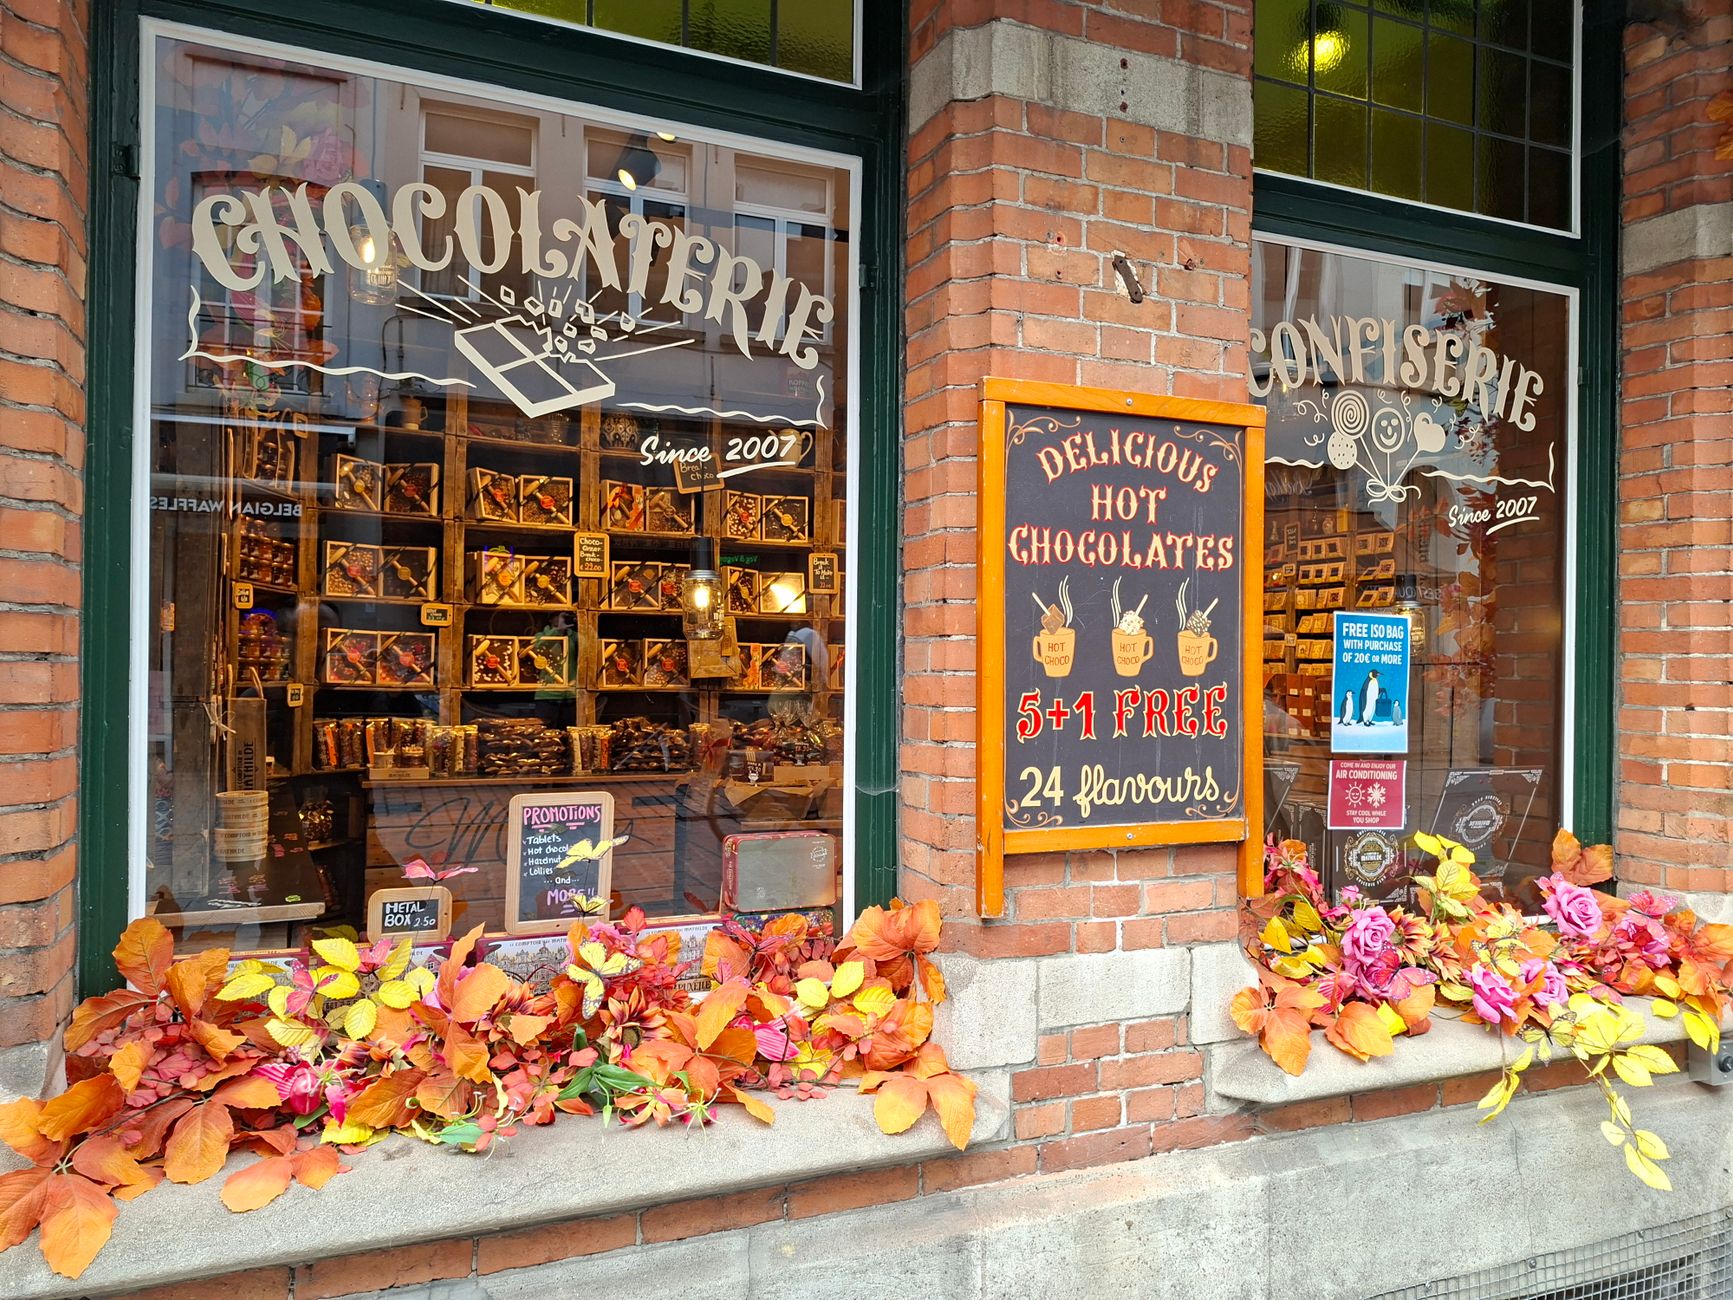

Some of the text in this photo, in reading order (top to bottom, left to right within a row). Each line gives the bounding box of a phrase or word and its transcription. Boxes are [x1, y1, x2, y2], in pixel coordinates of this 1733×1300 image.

[192, 181, 834, 370] CHOCOLATERIE
[1249, 314, 1544, 432] CONFISERIE
[640, 435, 798, 466] Since 2007
[1036, 429, 1219, 493] DELICIOUS
[1090, 483, 1166, 524] HOT
[1448, 496, 1537, 528] Since 2007
[1007, 522, 1234, 571] CHOCOLATES
[1342, 622, 1404, 639] FREE ISO BAG
[1048, 642, 1065, 652] HOT
[1119, 643, 1137, 652] HOT
[1185, 645, 1202, 655] HOT
[1343, 639, 1402, 651] WITH PURCHASE
[1044, 655, 1070, 665] CHOCO
[1116, 655, 1141, 665] CHOCO
[1181, 655, 1204, 666] CHOCO
[1342, 652, 1402, 664] OF 20€ OR MORE
[1016, 681, 1229, 744] 5+1 FREE
[1335, 769, 1398, 780] AIR CONDITIONING
[1019, 764, 1220, 818] 24 flavours
[526, 834, 562, 845] Tablets
[527, 846, 542, 855] Hot
[529, 867, 553, 876] Lollies
[385, 901, 425, 914] METAL
[384, 914, 436, 927] BOX 2.50
